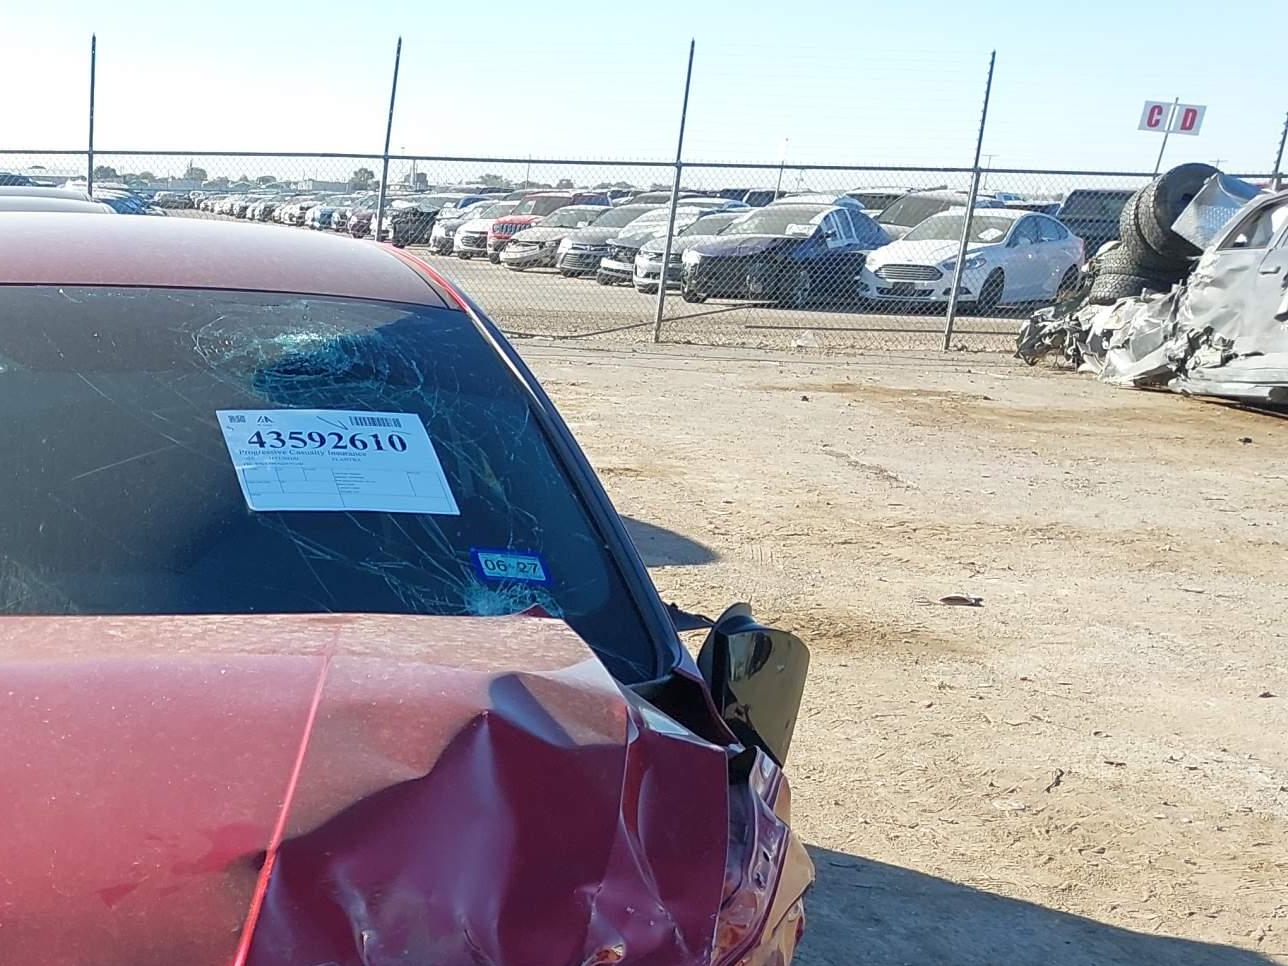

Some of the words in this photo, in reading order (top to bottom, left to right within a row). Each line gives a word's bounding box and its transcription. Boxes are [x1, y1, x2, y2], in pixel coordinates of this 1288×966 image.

[1146, 104, 1163, 128] C
[1179, 107, 1198, 131] D
[248, 430, 408, 452] 43592610
